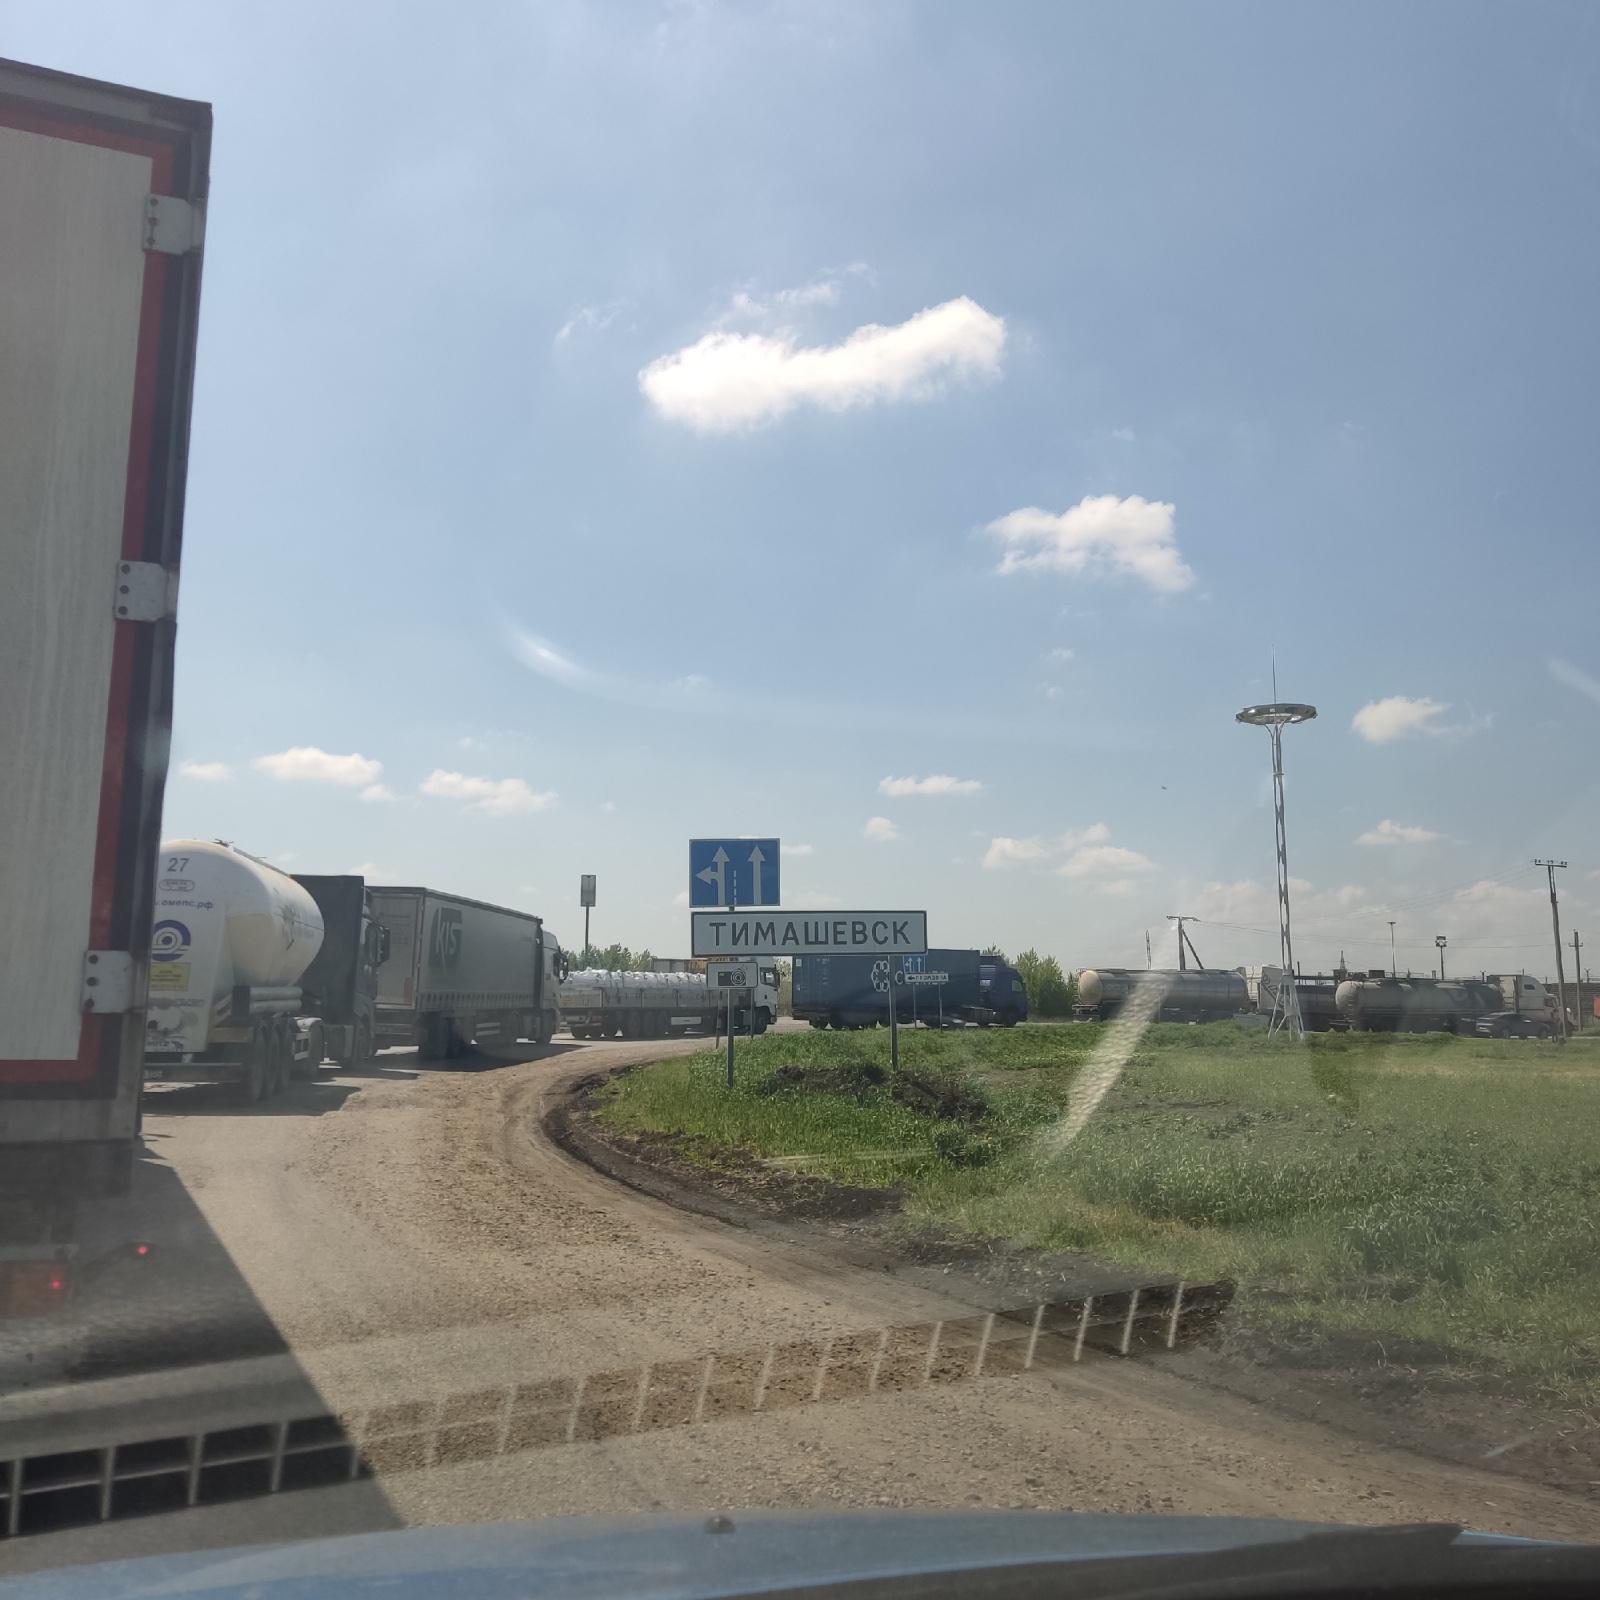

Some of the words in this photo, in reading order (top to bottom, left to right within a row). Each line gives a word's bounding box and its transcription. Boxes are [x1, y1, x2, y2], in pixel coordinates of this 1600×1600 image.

[167, 857, 190, 873] 27
[435, 907, 462, 969] KIS
[709, 920, 911, 946] ТИМАШЕВСК
